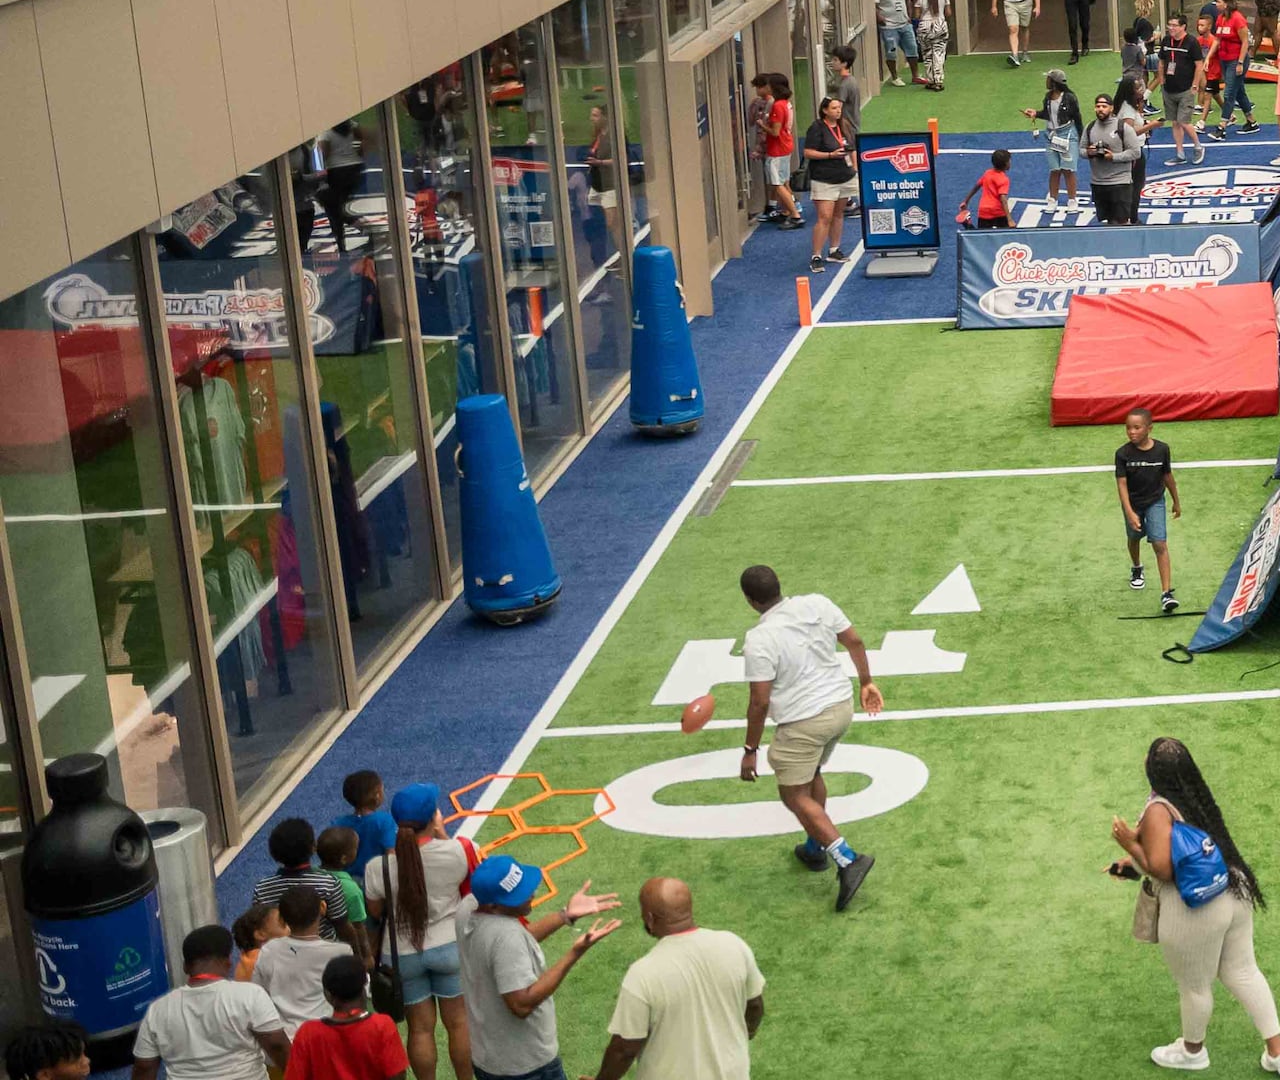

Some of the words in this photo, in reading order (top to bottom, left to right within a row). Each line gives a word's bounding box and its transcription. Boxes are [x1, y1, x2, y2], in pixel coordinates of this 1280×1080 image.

[909, 153, 924, 165] EXIT
[871, 180, 886, 191] Tell
[888, 182, 898, 190] us
[899, 179, 925, 190] about
[877, 192, 896, 202] your
[898, 190, 920, 200] visit!
[1210, 213, 1238, 222] OF
[1001, 248, 1086, 281] Chick-fil-A
[1088, 261, 1154, 282] PEACH
[1154, 259, 1216, 278] BOWL
[1014, 286, 1107, 312] SKI
[1247, 517, 1272, 573] SKILL
[1230, 568, 1258, 616] ZONE
[58, 943, 79, 951] Here
